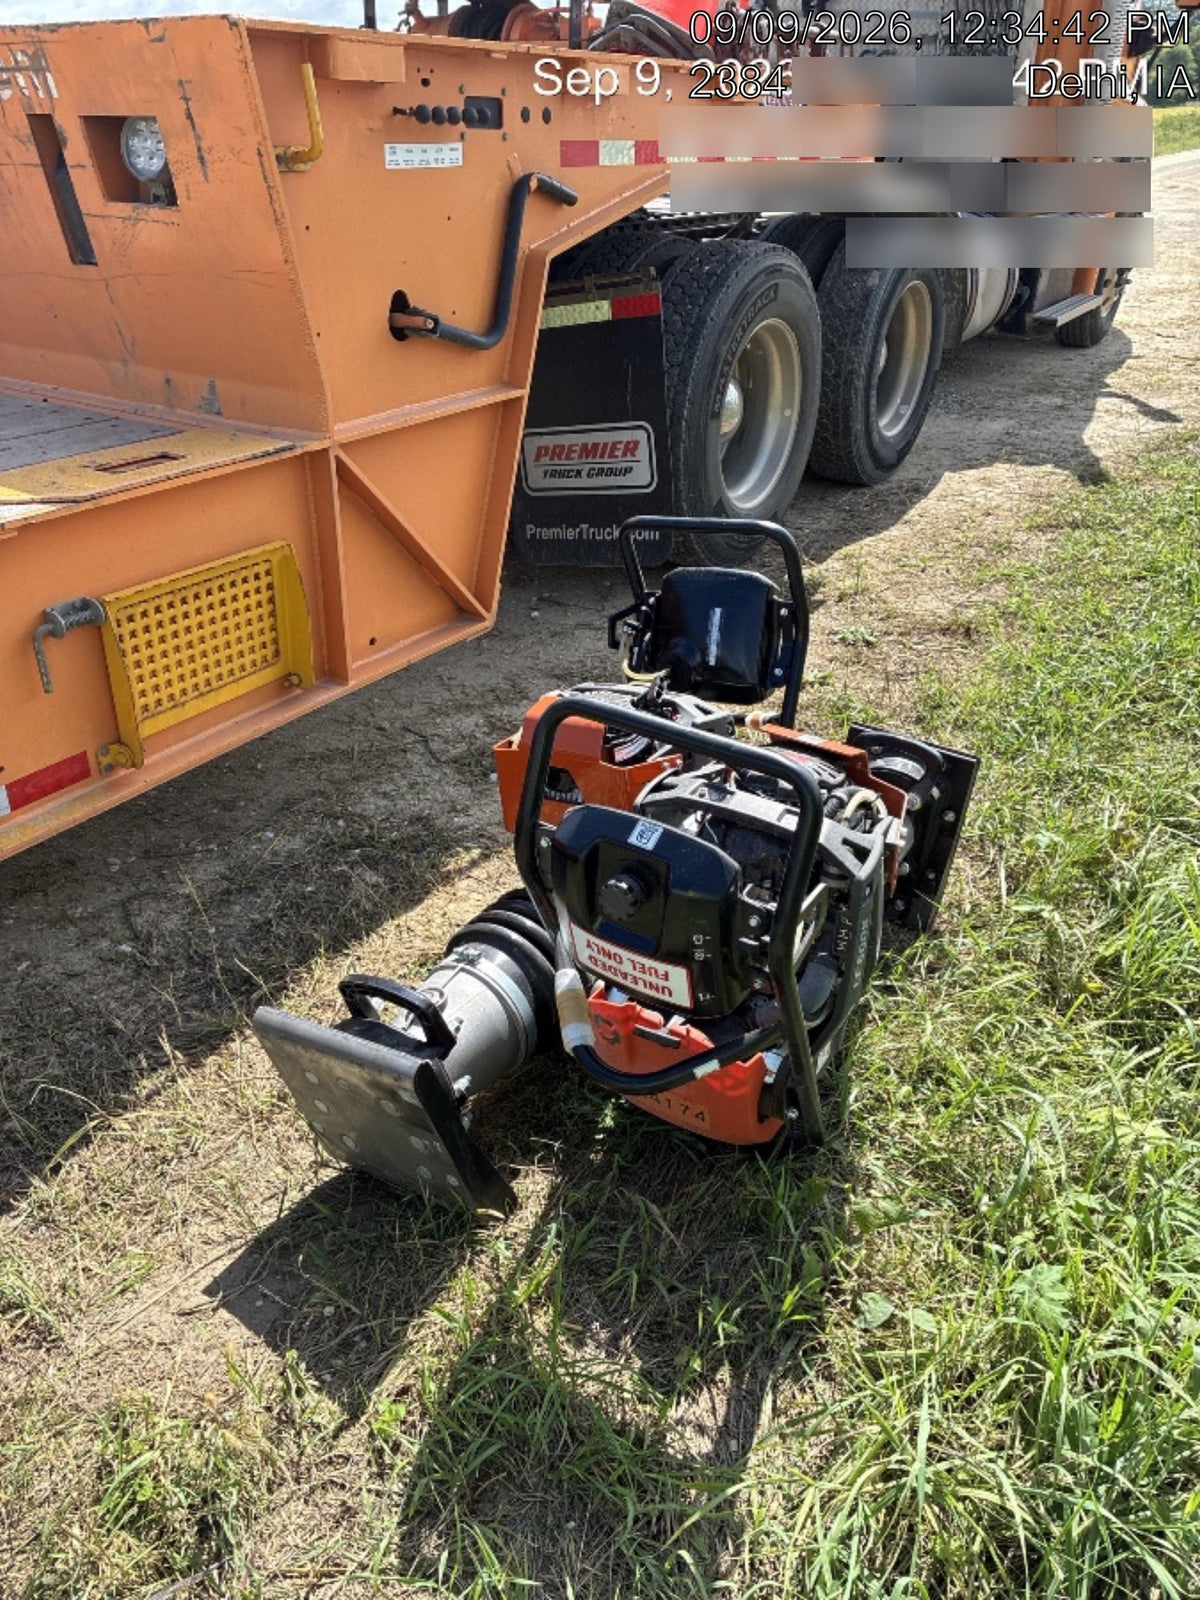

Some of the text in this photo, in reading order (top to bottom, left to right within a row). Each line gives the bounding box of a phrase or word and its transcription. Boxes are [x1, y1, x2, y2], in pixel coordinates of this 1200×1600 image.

[533, 440, 640, 463] PREMIER
[543, 466, 633, 479] TRUCK GROUP
[526, 523, 660, 540] PremierTruckom
[585, 938, 670, 982] FUEL ONLY
[588, 954, 673, 998] UNLEADED
